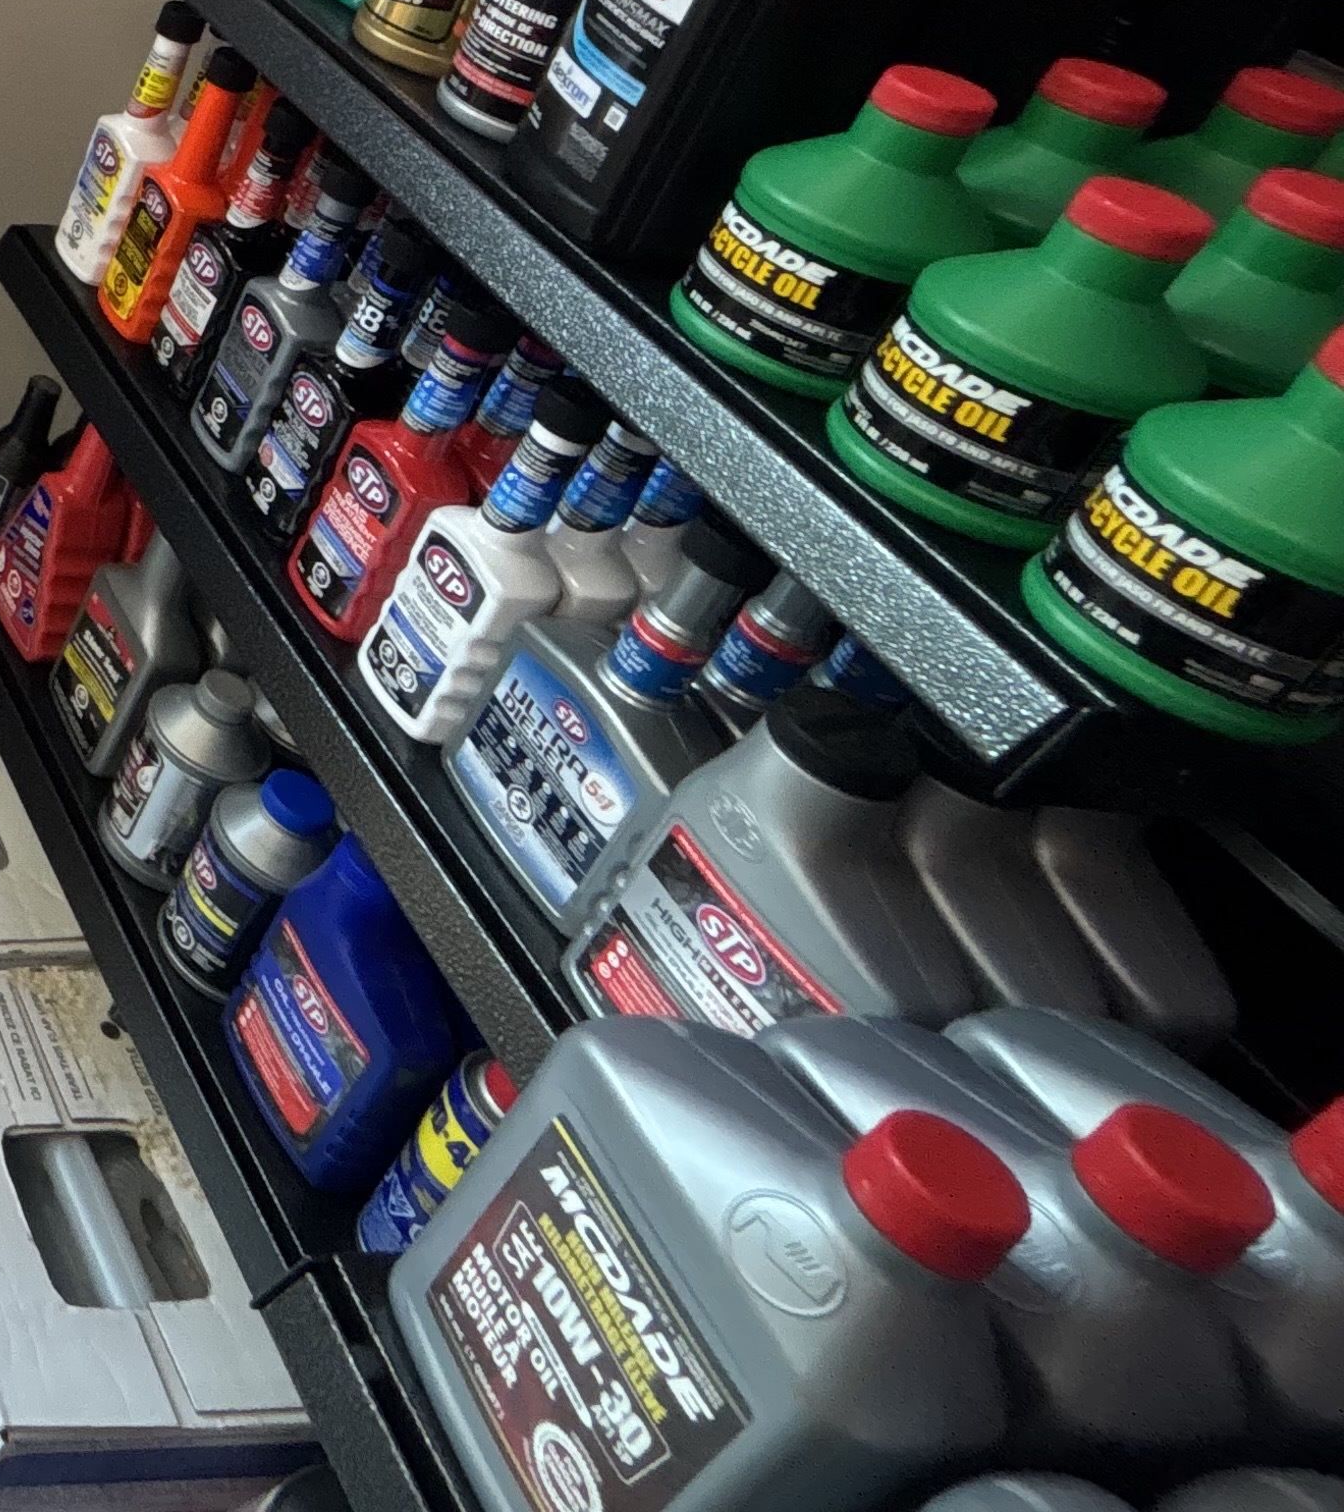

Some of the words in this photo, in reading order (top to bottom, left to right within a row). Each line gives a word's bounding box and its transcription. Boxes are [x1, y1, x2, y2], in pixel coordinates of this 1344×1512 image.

[551, 60, 592, 108] dexron
[96, 141, 116, 169] STP
[145, 191, 163, 216] STP
[191, 247, 217, 282] STP
[771, 268, 821, 310] OIL
[244, 312, 273, 348] STP
[295, 383, 329, 425] STP
[952, 397, 1013, 443] OIL
[343, 490, 370, 523] GAS
[351, 464, 390, 510] STP
[427, 554, 466, 598] STP
[1170, 563, 1240, 621] OIL
[499, 692, 570, 783] DIESEL
[505, 678, 591, 785] ULTRA
[552, 702, 584, 738] STP
[194, 848, 213, 883] STP
[652, 897, 701, 961] HIGH
[701, 915, 757, 974] STP
[291, 981, 325, 1028] STP
[9, 1031, 23, 1048] CE
[28, 1084, 42, 1102] ICI
[497, 1220, 548, 1281] SAE
[455, 1256, 513, 1340] HUILE
[538, 1159, 716, 1431] MCDADE
[561, 1228, 603, 1288] HIGH
[595, 1285, 659, 1382] MILEAGE
[446, 1269, 522, 1389] MOTEUR
[467, 1241, 536, 1349] MOTOR
[525, 1344, 566, 1402] OIL
[588, 1401, 617, 1441] API
[611, 1440, 635, 1470] SP
